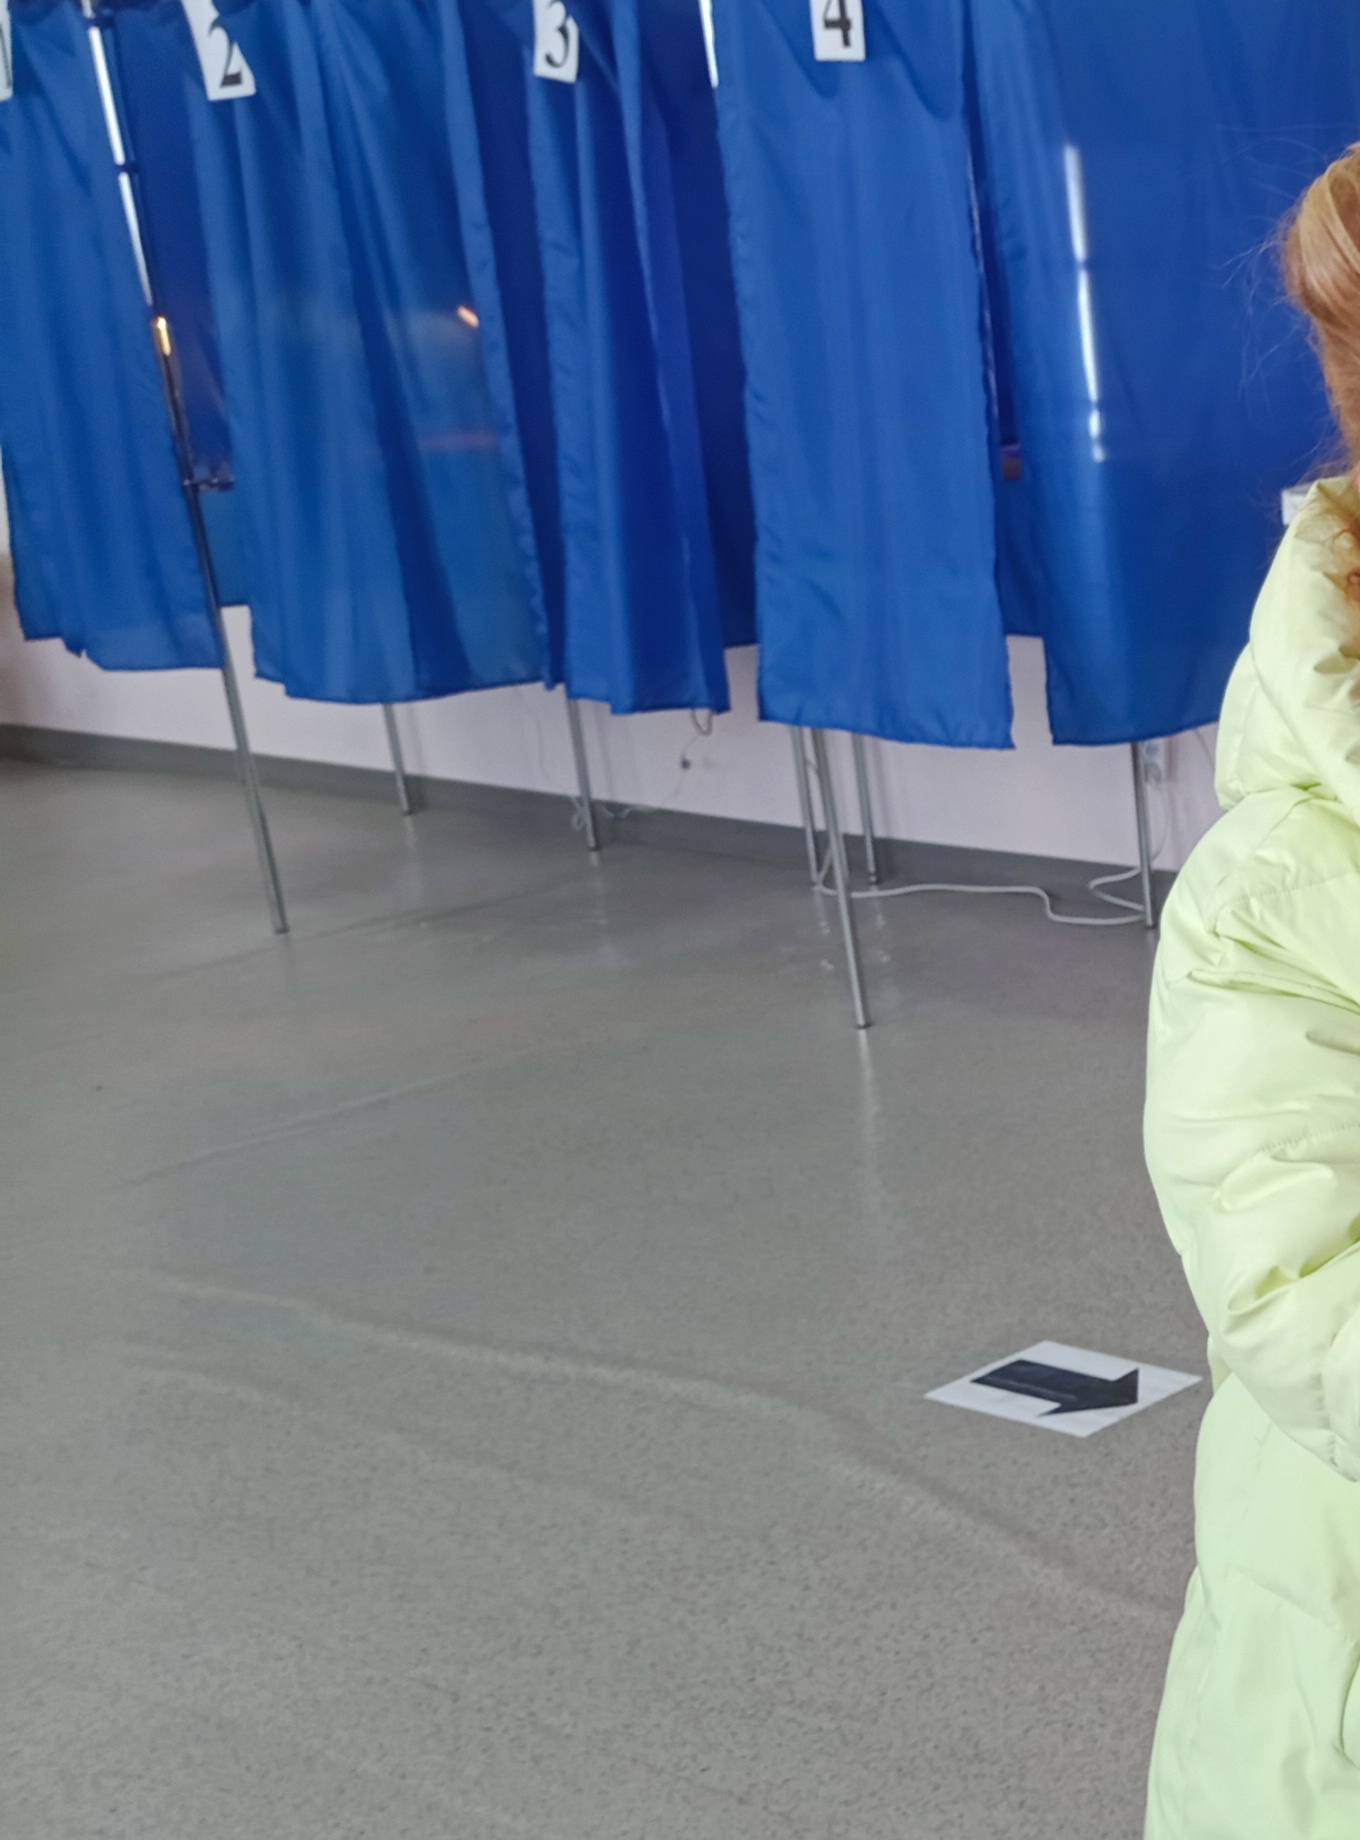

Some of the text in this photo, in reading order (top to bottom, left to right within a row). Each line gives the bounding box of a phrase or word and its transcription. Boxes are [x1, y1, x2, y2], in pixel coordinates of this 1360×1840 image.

[208, 18, 243, 88] 2
[545, 0, 570, 69] 3
[822, 0, 852, 48] 4
